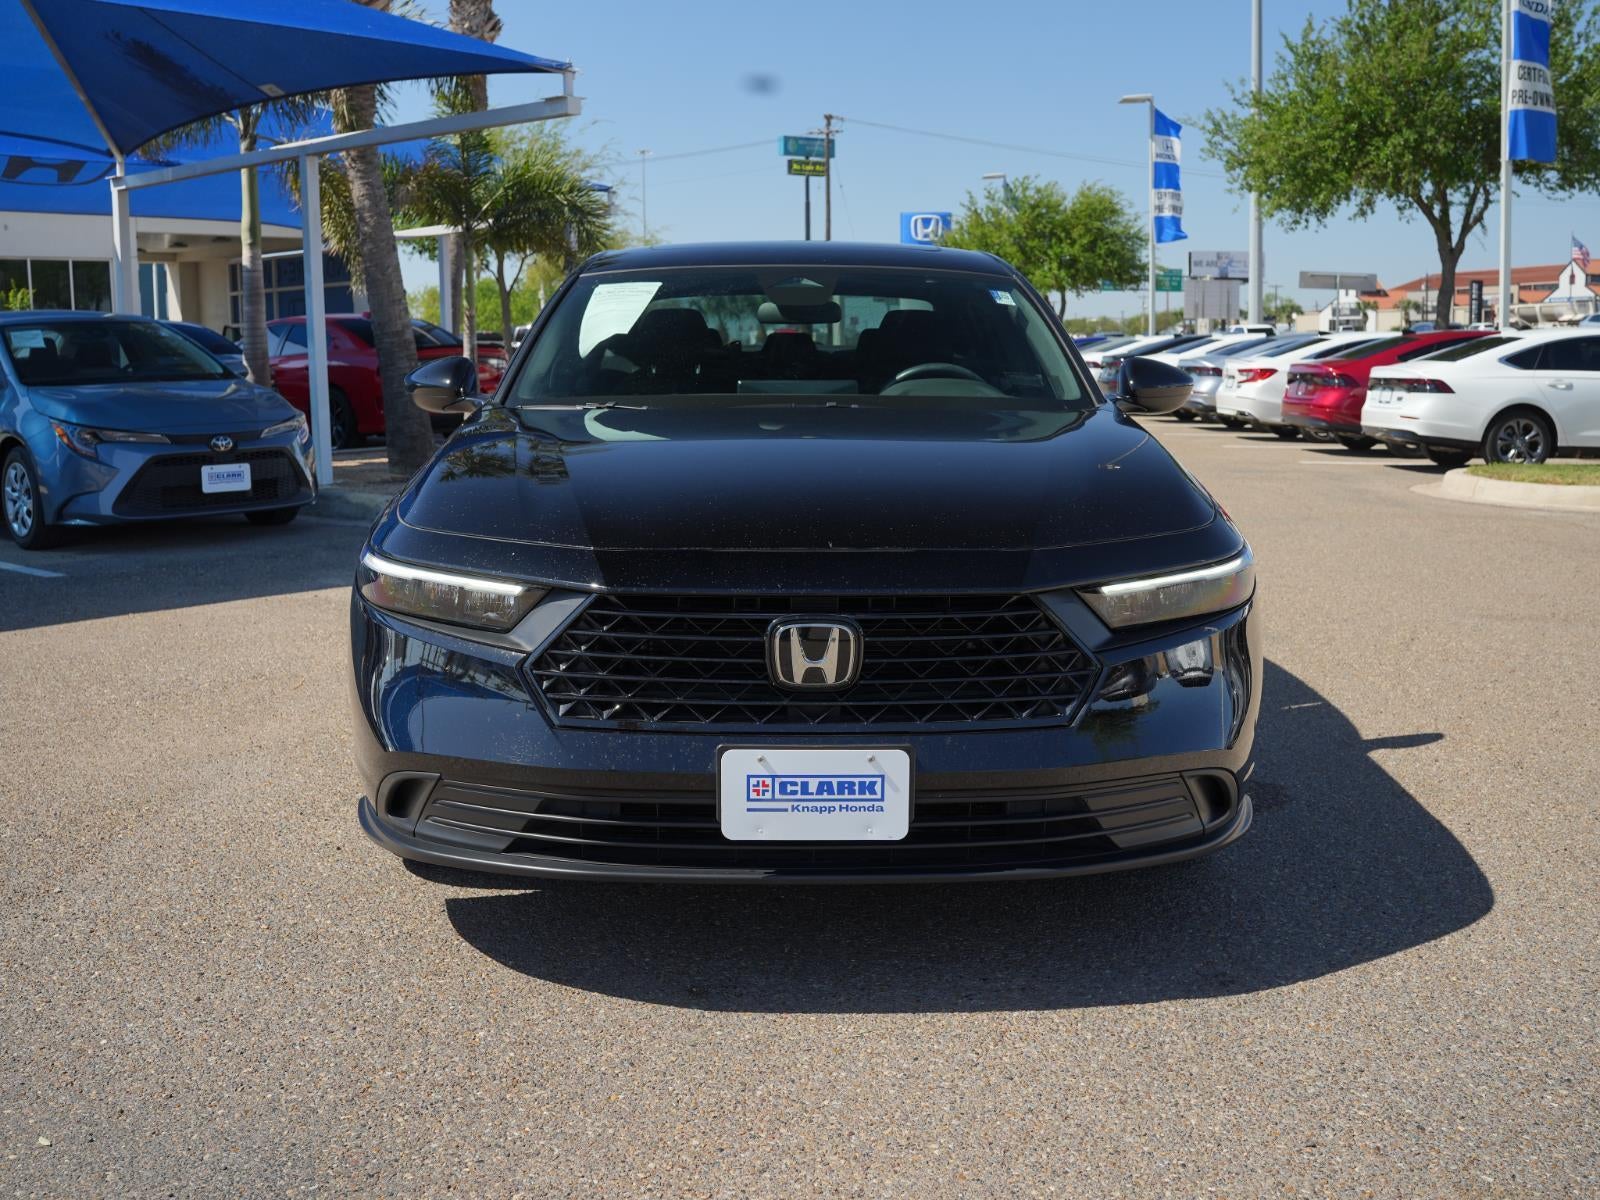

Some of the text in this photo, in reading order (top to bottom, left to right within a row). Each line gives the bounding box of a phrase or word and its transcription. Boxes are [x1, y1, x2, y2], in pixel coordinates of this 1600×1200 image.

[778, 780, 878, 796] CLARK
[791, 804, 884, 814] Knapp Honda
